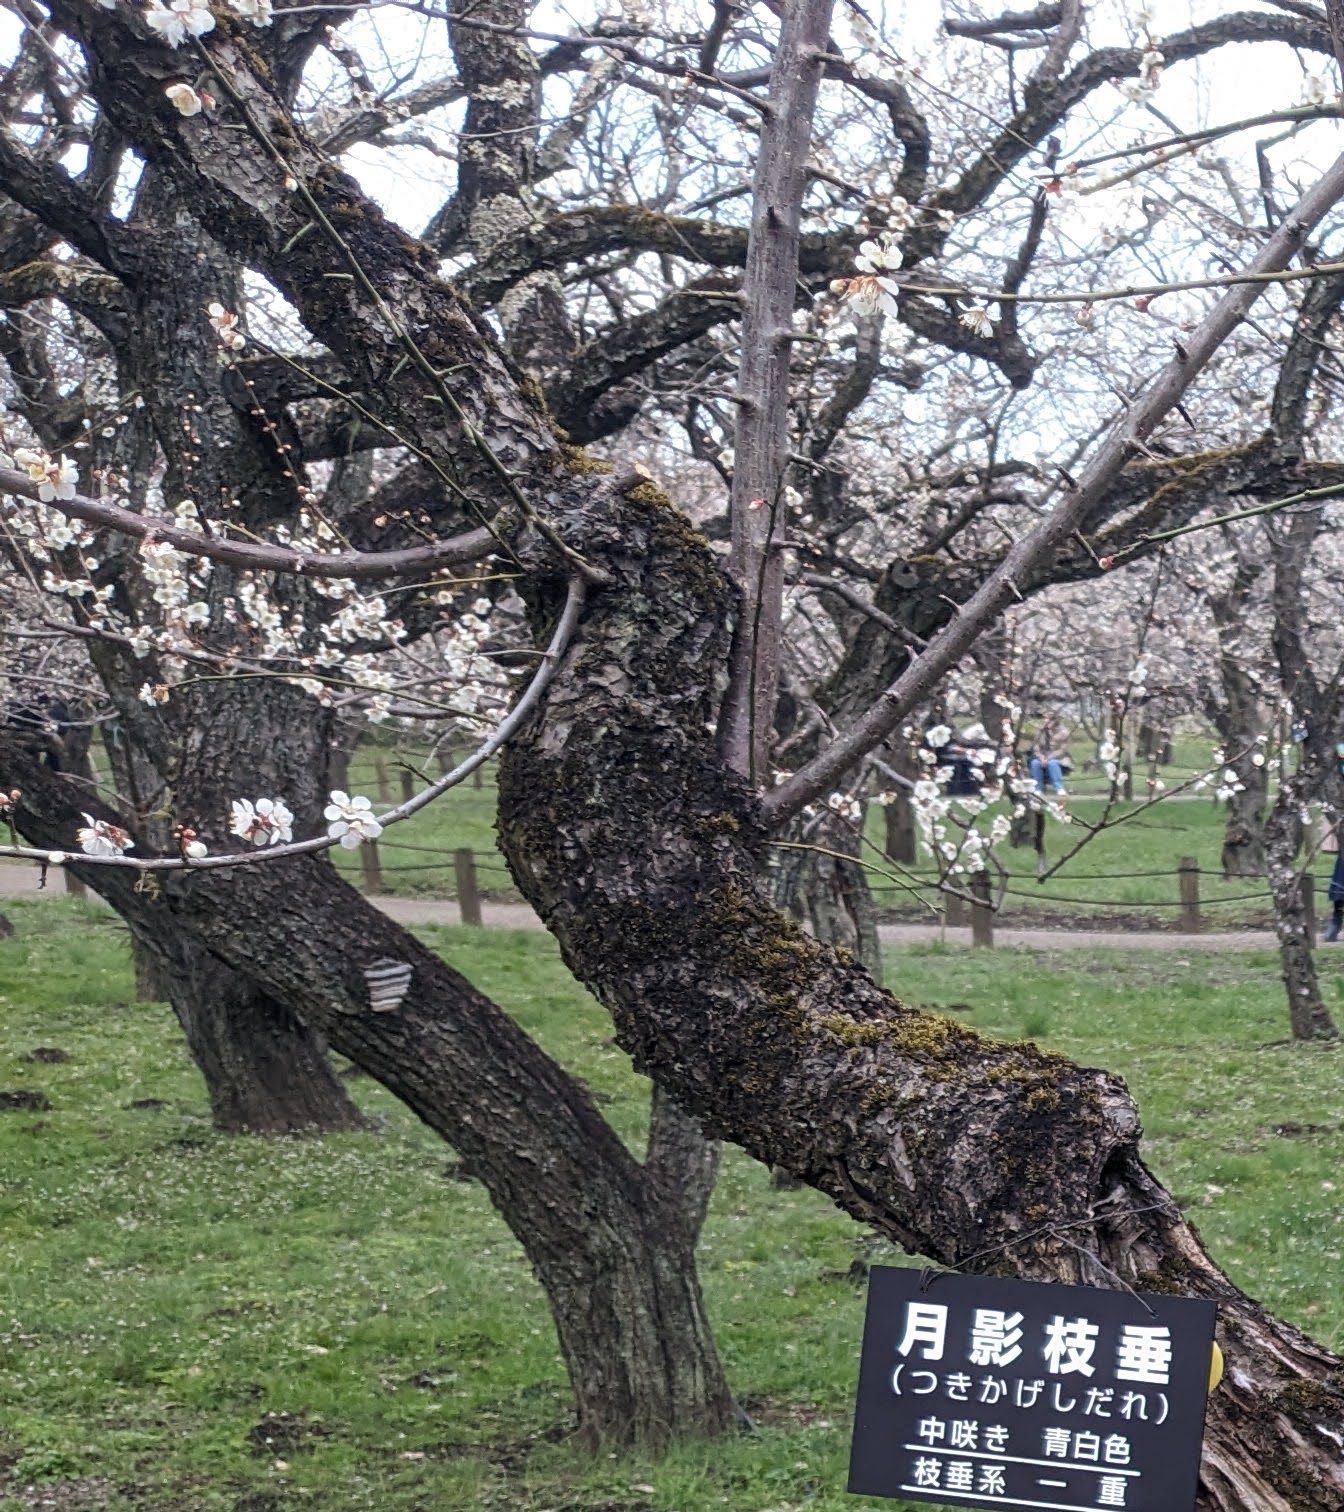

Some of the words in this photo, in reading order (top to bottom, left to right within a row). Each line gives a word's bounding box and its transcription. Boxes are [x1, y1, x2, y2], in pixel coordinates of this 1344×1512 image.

[896, 1300, 1174, 1386] 月影枝垂
[918, 1414, 1011, 1454] 中咲き
[1042, 1426, 1133, 1466] 青白色
[913, 1454, 1007, 1496] 枝垂系
